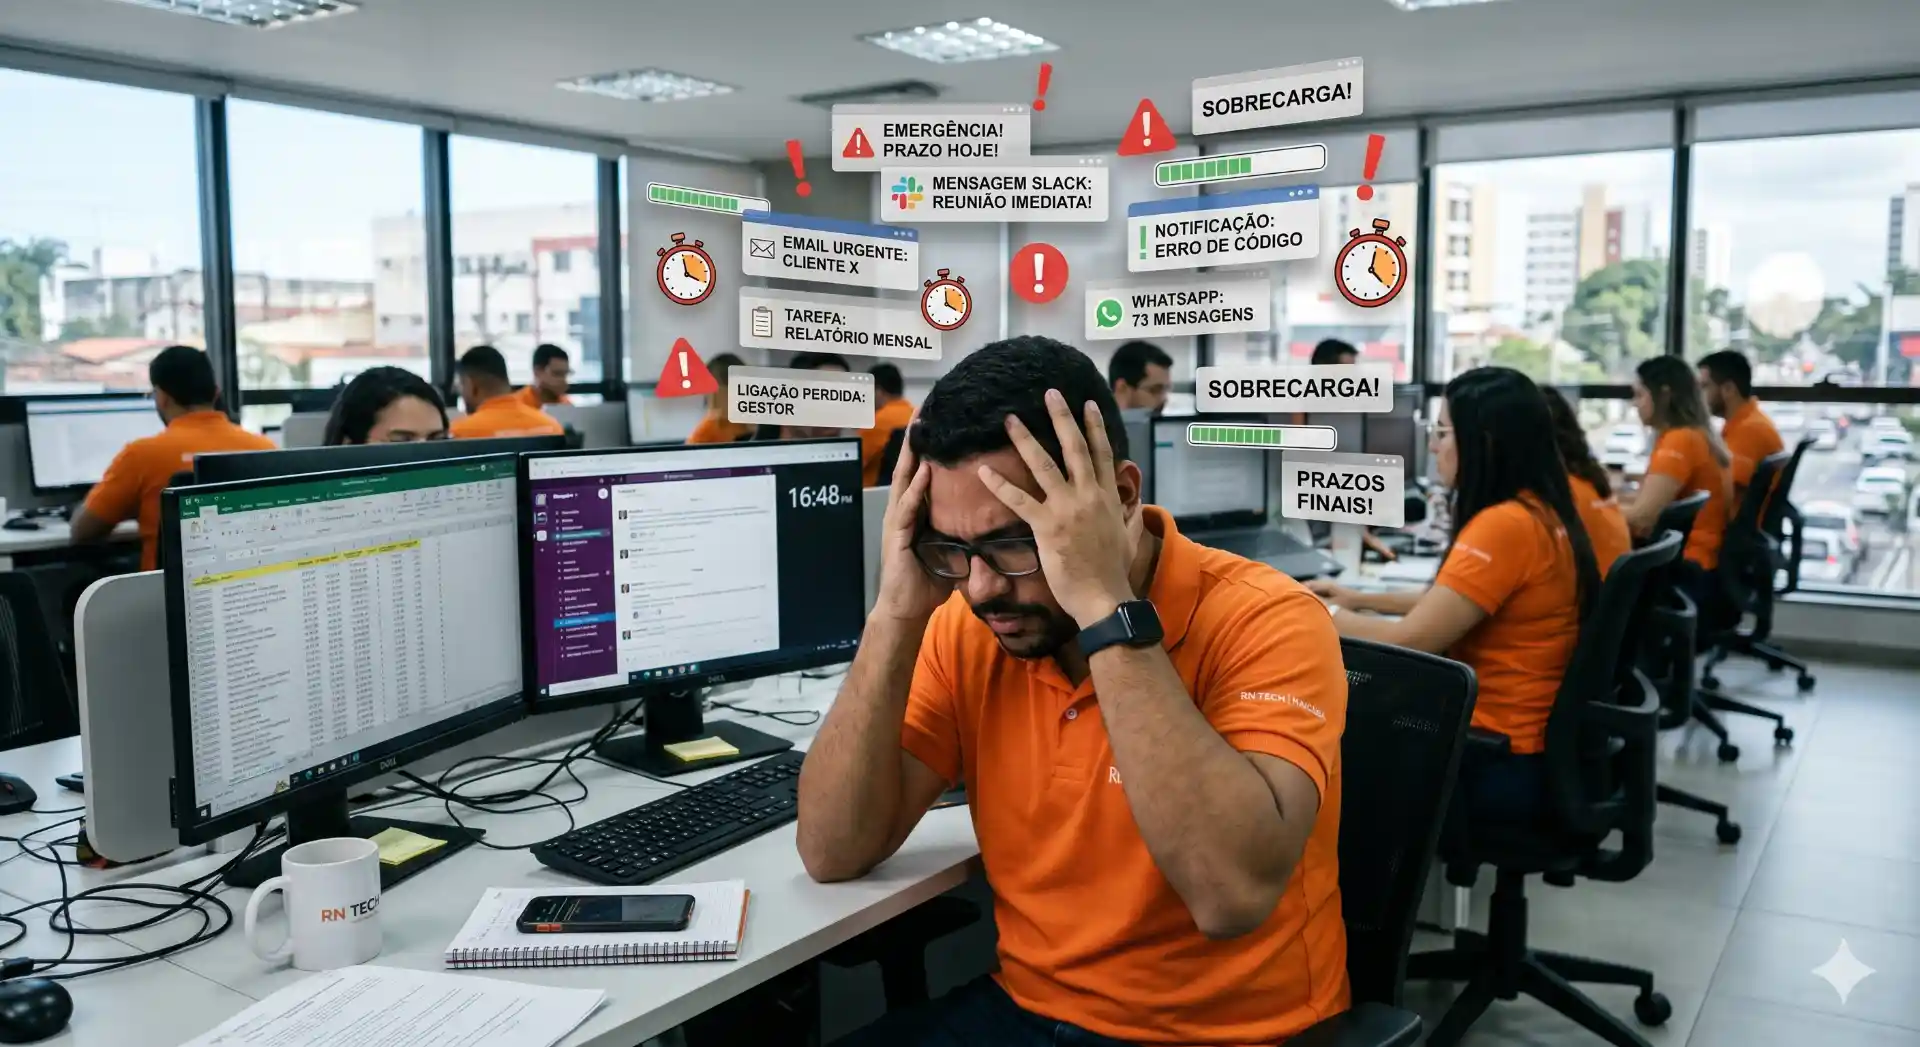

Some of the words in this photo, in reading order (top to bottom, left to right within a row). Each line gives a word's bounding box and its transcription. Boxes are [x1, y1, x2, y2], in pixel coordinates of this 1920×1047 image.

[788, 484, 840, 508] 16:48
[1240, 691, 1256, 701] RN
[1258, 692, 1286, 702] TECH
[321, 908, 346, 922] RN
[350, 894, 380, 917] TECH
